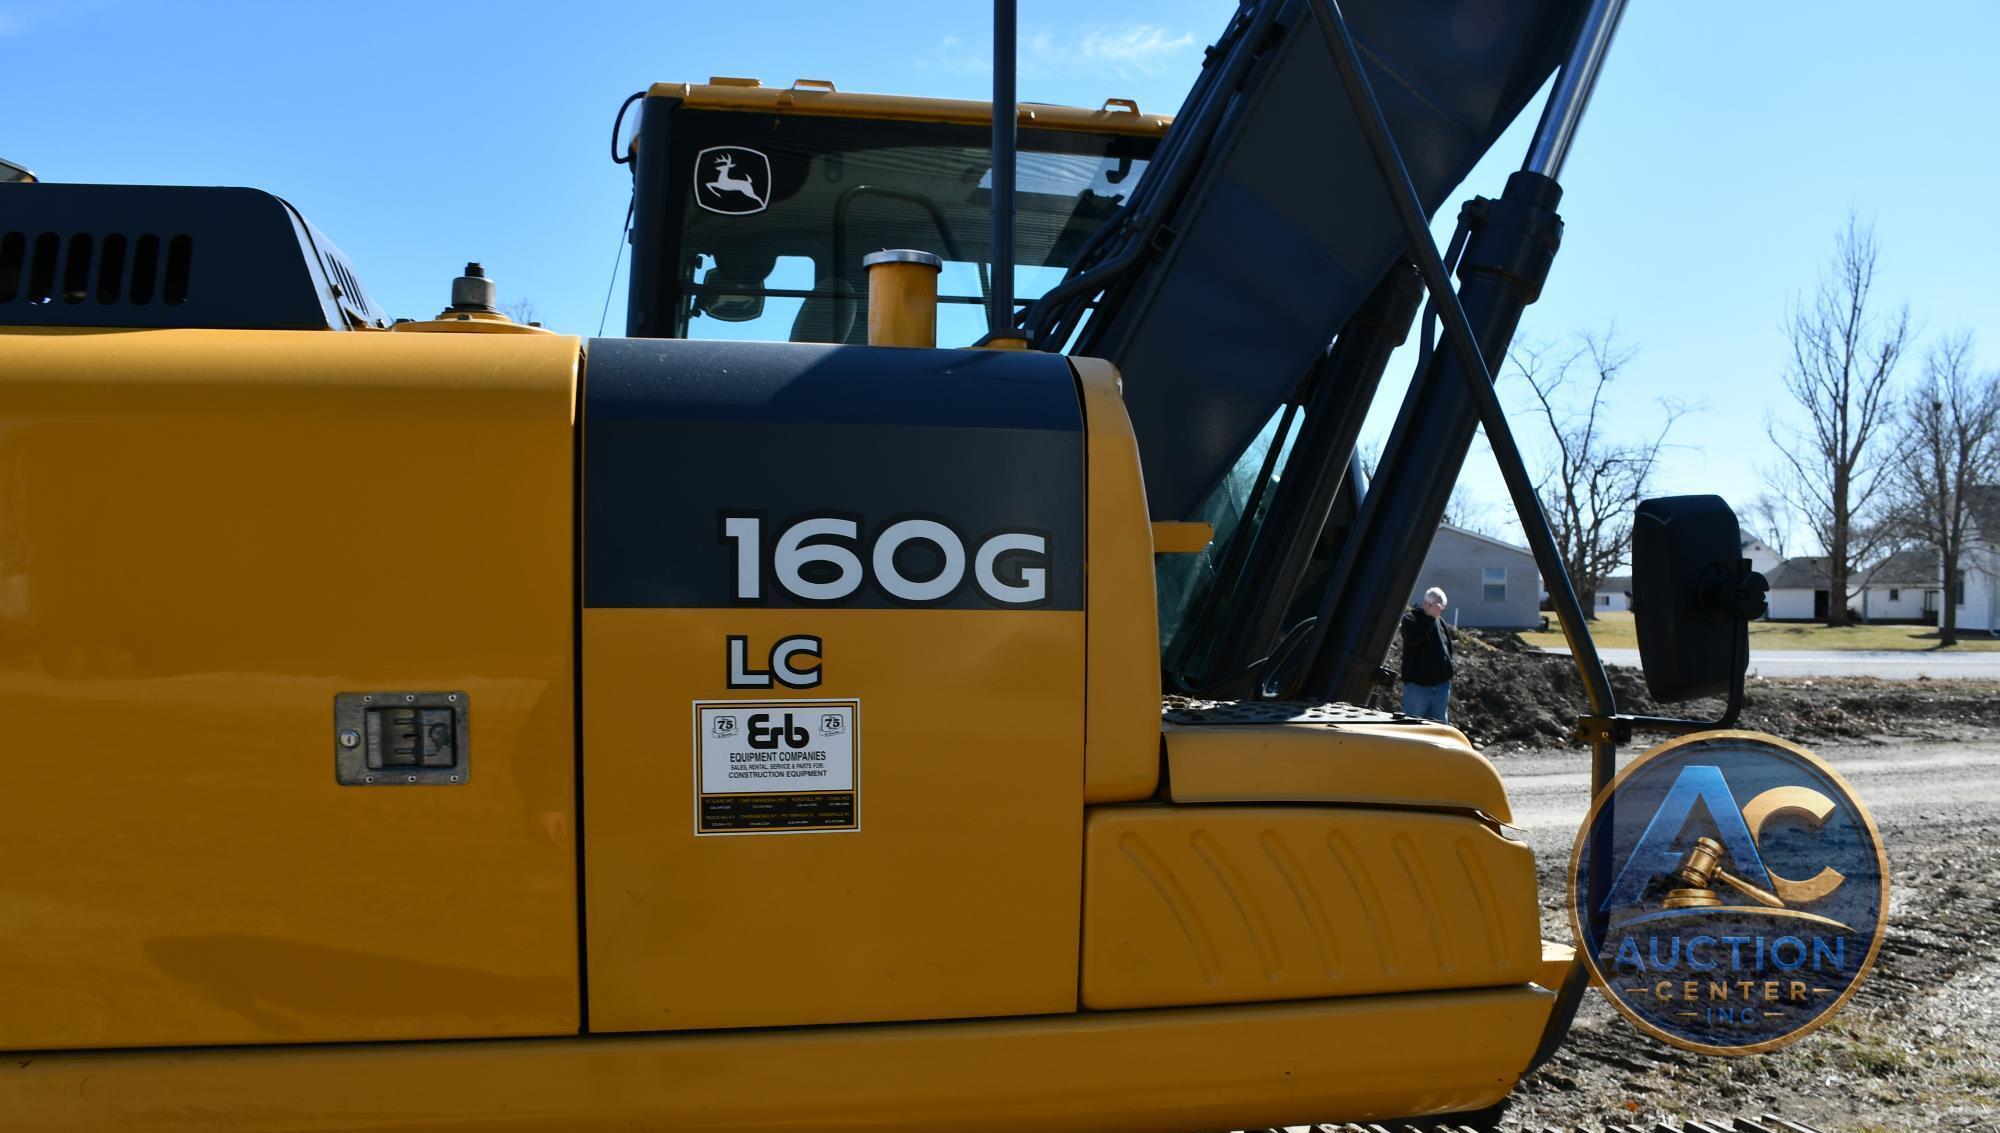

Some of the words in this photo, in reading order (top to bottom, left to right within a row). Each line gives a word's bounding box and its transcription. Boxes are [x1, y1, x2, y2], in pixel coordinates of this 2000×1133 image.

[725, 517, 1046, 603] 160G
[728, 636, 822, 688] LC
[717, 720, 734, 730] 75
[824, 718, 841, 728] 75
[747, 713, 810, 749] Erb
[730, 751, 777, 762] EQUIPMENT
[778, 750, 826, 762] COMPANIES
[728, 771, 785, 779] CONSTRUCTION
[786, 770, 827, 778] EQUIPMENT
